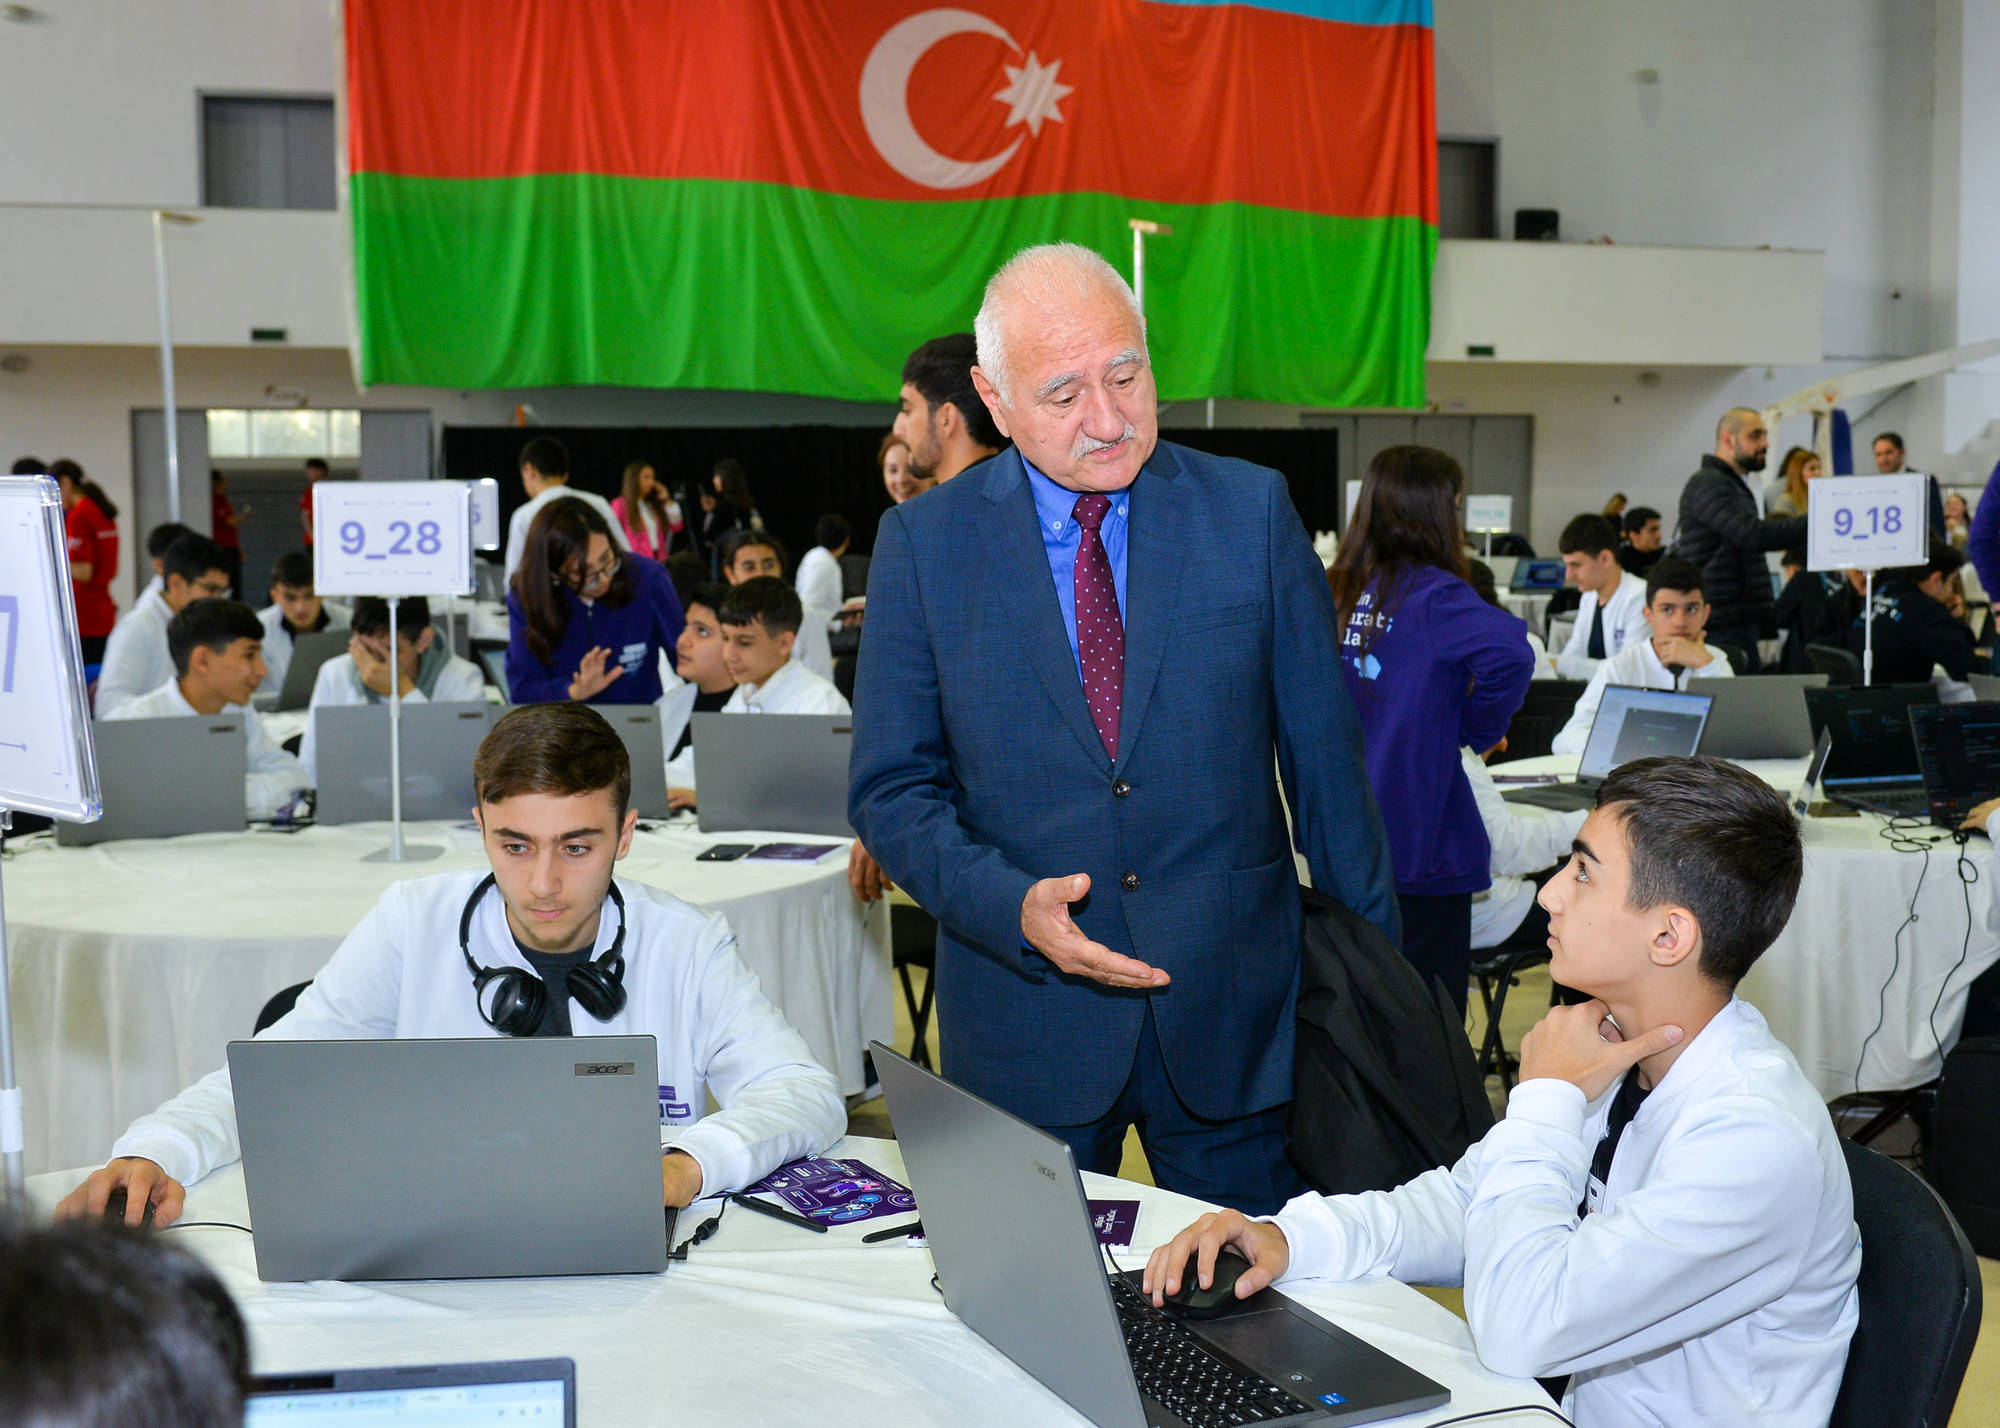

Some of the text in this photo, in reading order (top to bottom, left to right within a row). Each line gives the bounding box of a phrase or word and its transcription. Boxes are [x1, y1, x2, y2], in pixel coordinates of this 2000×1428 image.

[1834, 506, 1902, 539] 9_18
[340, 520, 442, 560] 9_28
[587, 1065, 623, 1074] acer
